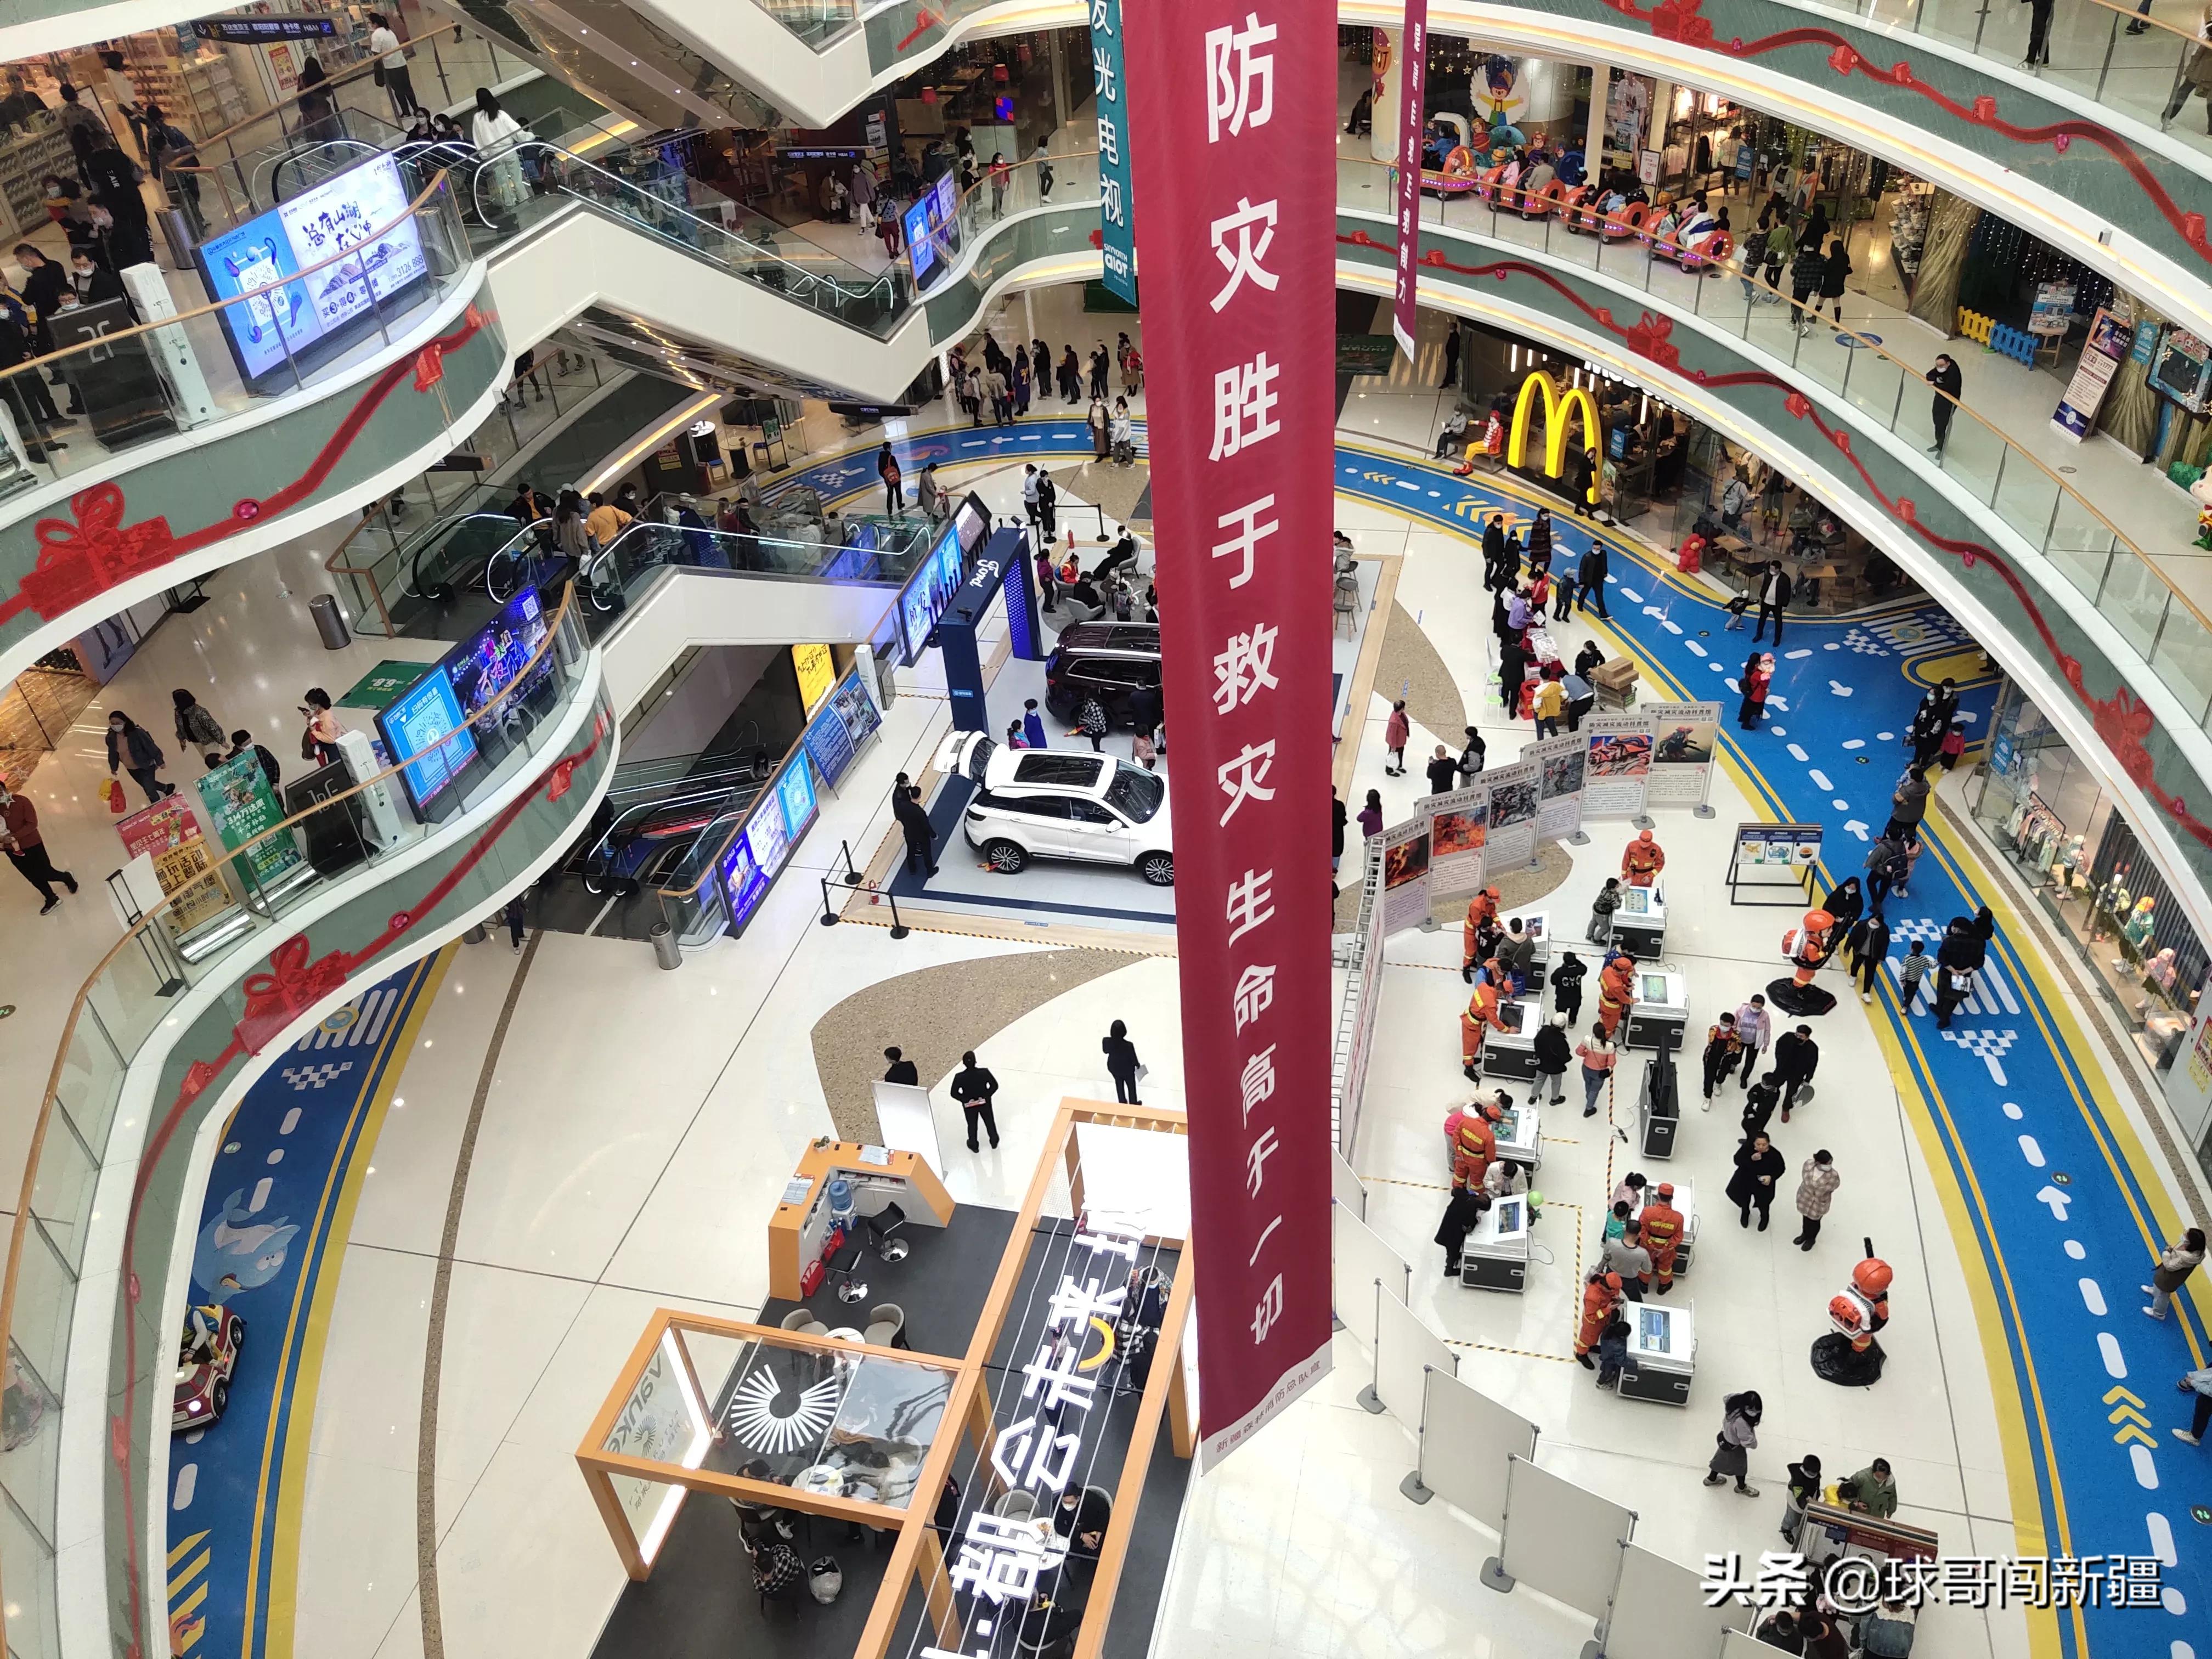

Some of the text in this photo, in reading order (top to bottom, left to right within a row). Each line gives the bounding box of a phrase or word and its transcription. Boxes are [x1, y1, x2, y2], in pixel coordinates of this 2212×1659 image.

[302, 201, 362, 246] 总有山湖
[1103, 243, 1128, 263] SKYWORTH
[969, 559, 999, 588] Ford
[1205, 12, 1283, 1346] 防灾胜于救灾生命高于一切
[1216, 1360, 1321, 1453] 新疆森林消防总队宣
